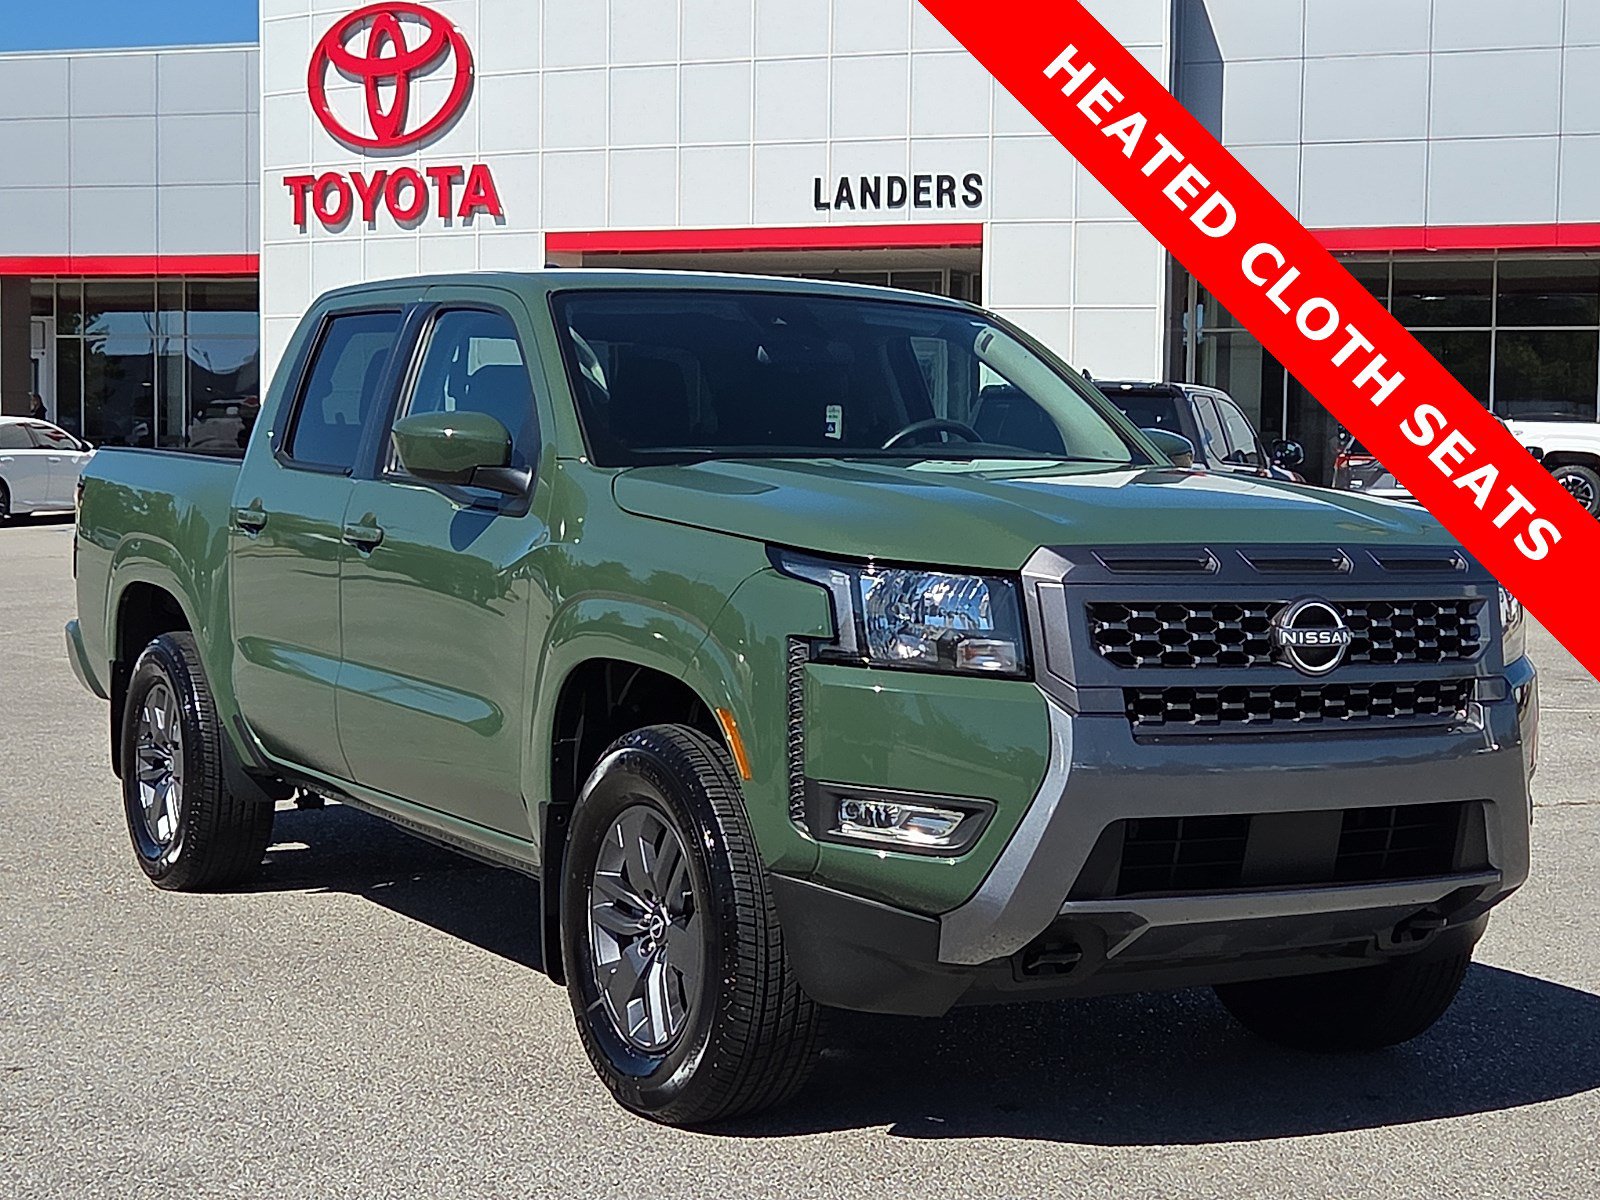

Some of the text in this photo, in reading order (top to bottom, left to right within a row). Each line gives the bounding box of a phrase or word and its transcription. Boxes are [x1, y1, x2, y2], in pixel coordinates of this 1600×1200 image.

[284, 164, 503, 226] TOYOTA
[814, 173, 983, 210] LANDERS
[1281, 631, 1354, 644] NISSAN
